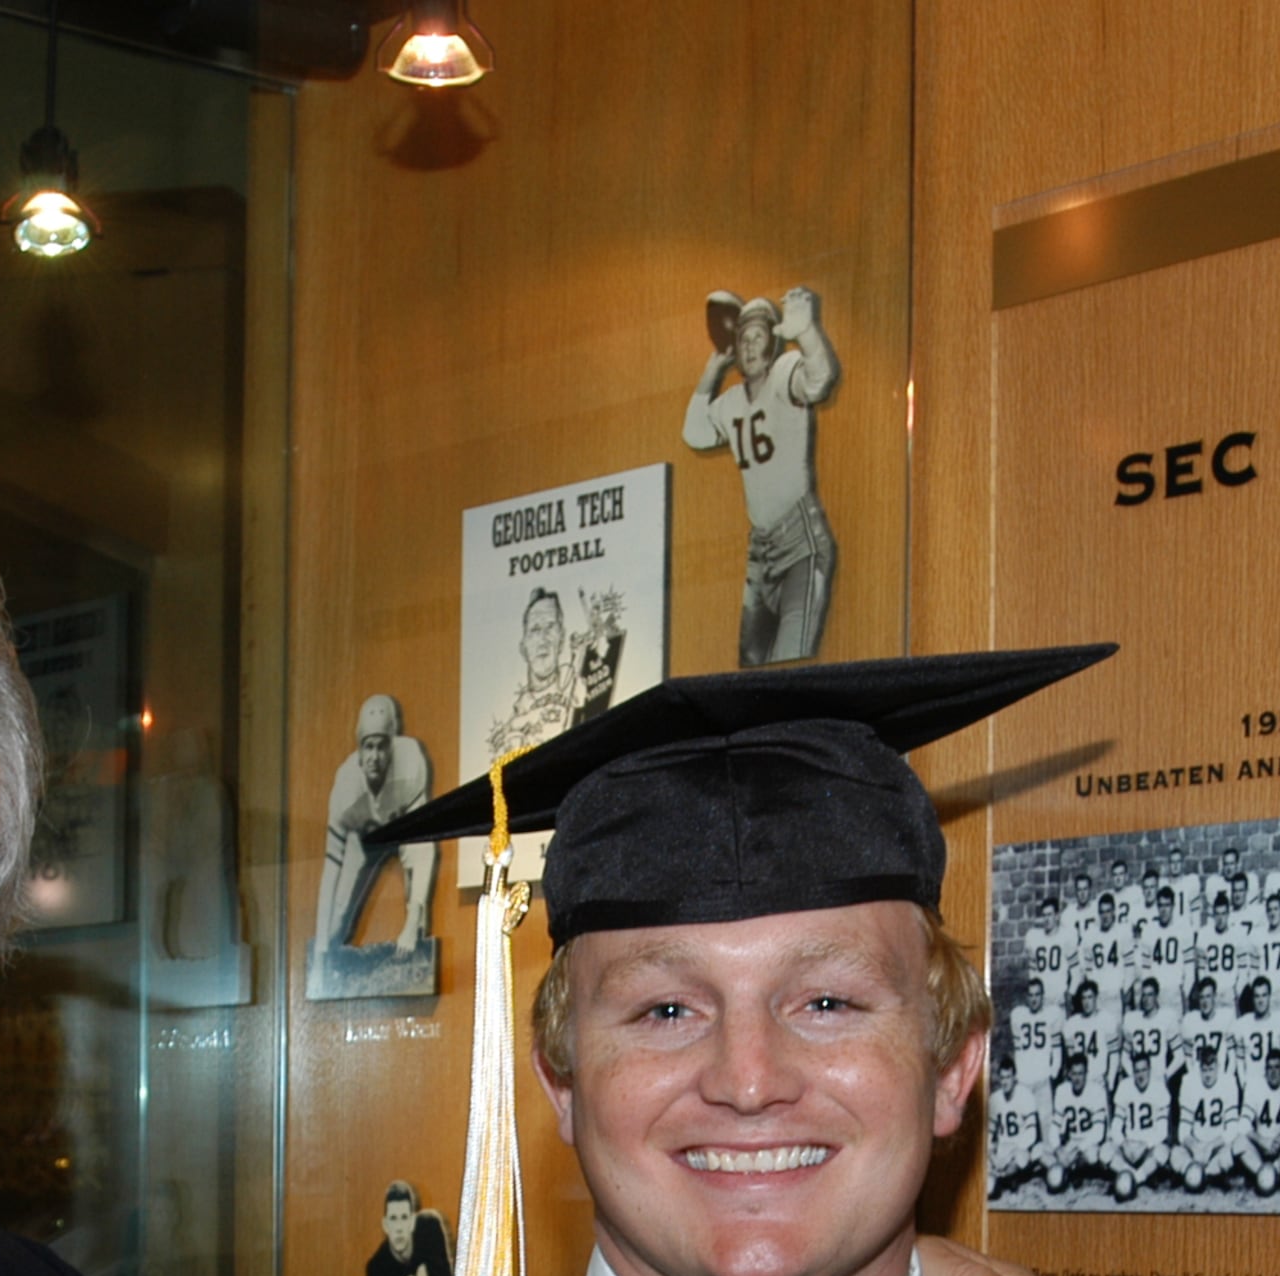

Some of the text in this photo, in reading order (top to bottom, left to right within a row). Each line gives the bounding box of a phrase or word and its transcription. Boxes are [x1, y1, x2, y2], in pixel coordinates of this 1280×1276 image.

[732, 410, 775, 470] 16
[1114, 431, 1259, 506] SEC
[492, 485, 625, 549] GEORGIA TECH
[509, 538, 605, 577] FOOTBALL
[1035, 945, 1062, 972] 60
[1092, 940, 1118, 968] 64
[1152, 937, 1178, 965] 40
[1207, 943, 1235, 972] 28
[1020, 1022, 1047, 1050] 35
[1074, 1029, 1099, 1057] 34
[1132, 1029, 1161, 1056] 33
[1249, 1030, 1273, 1061] 31
[1128, 1102, 1153, 1130] 12
[1194, 1098, 1223, 1127] 42
